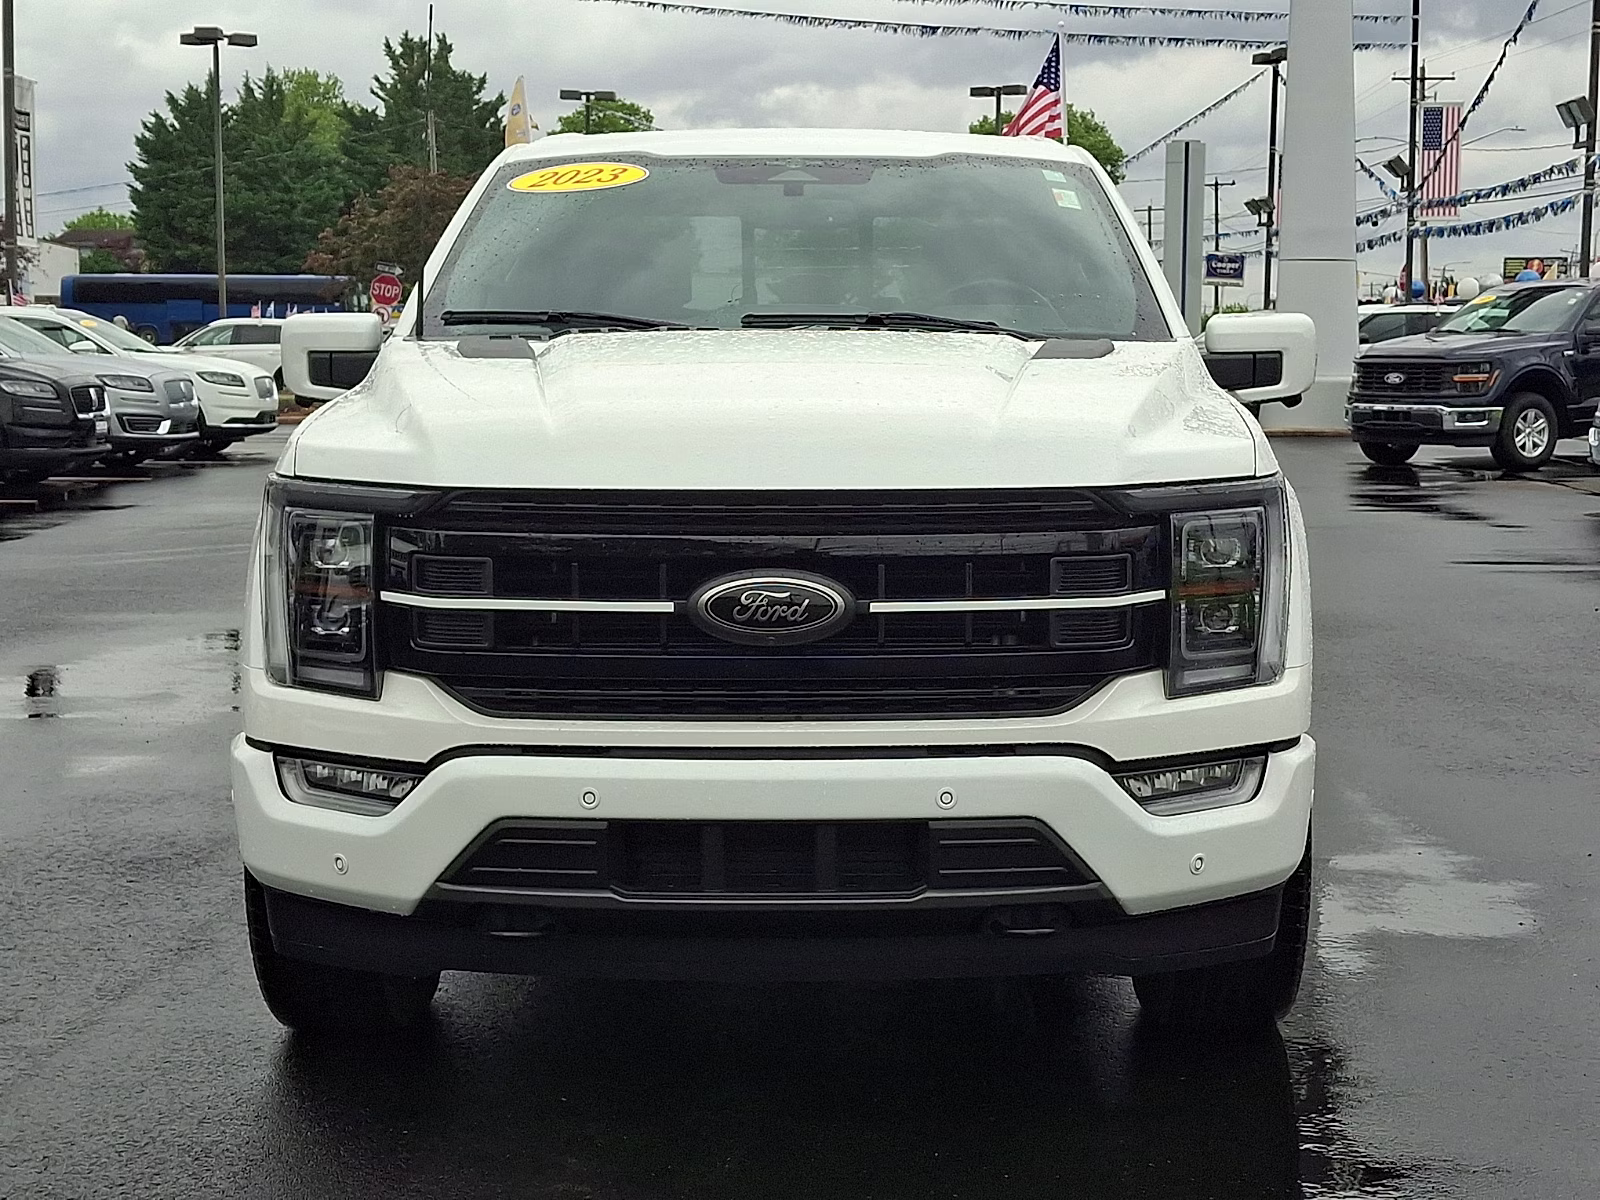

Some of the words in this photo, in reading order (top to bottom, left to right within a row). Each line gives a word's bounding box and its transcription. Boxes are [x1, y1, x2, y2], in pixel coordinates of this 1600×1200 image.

[528, 168, 628, 188] 2023
[1211, 260, 1240, 269] Cooper
[372, 283, 400, 298] STOP
[732, 590, 810, 622] Ford
